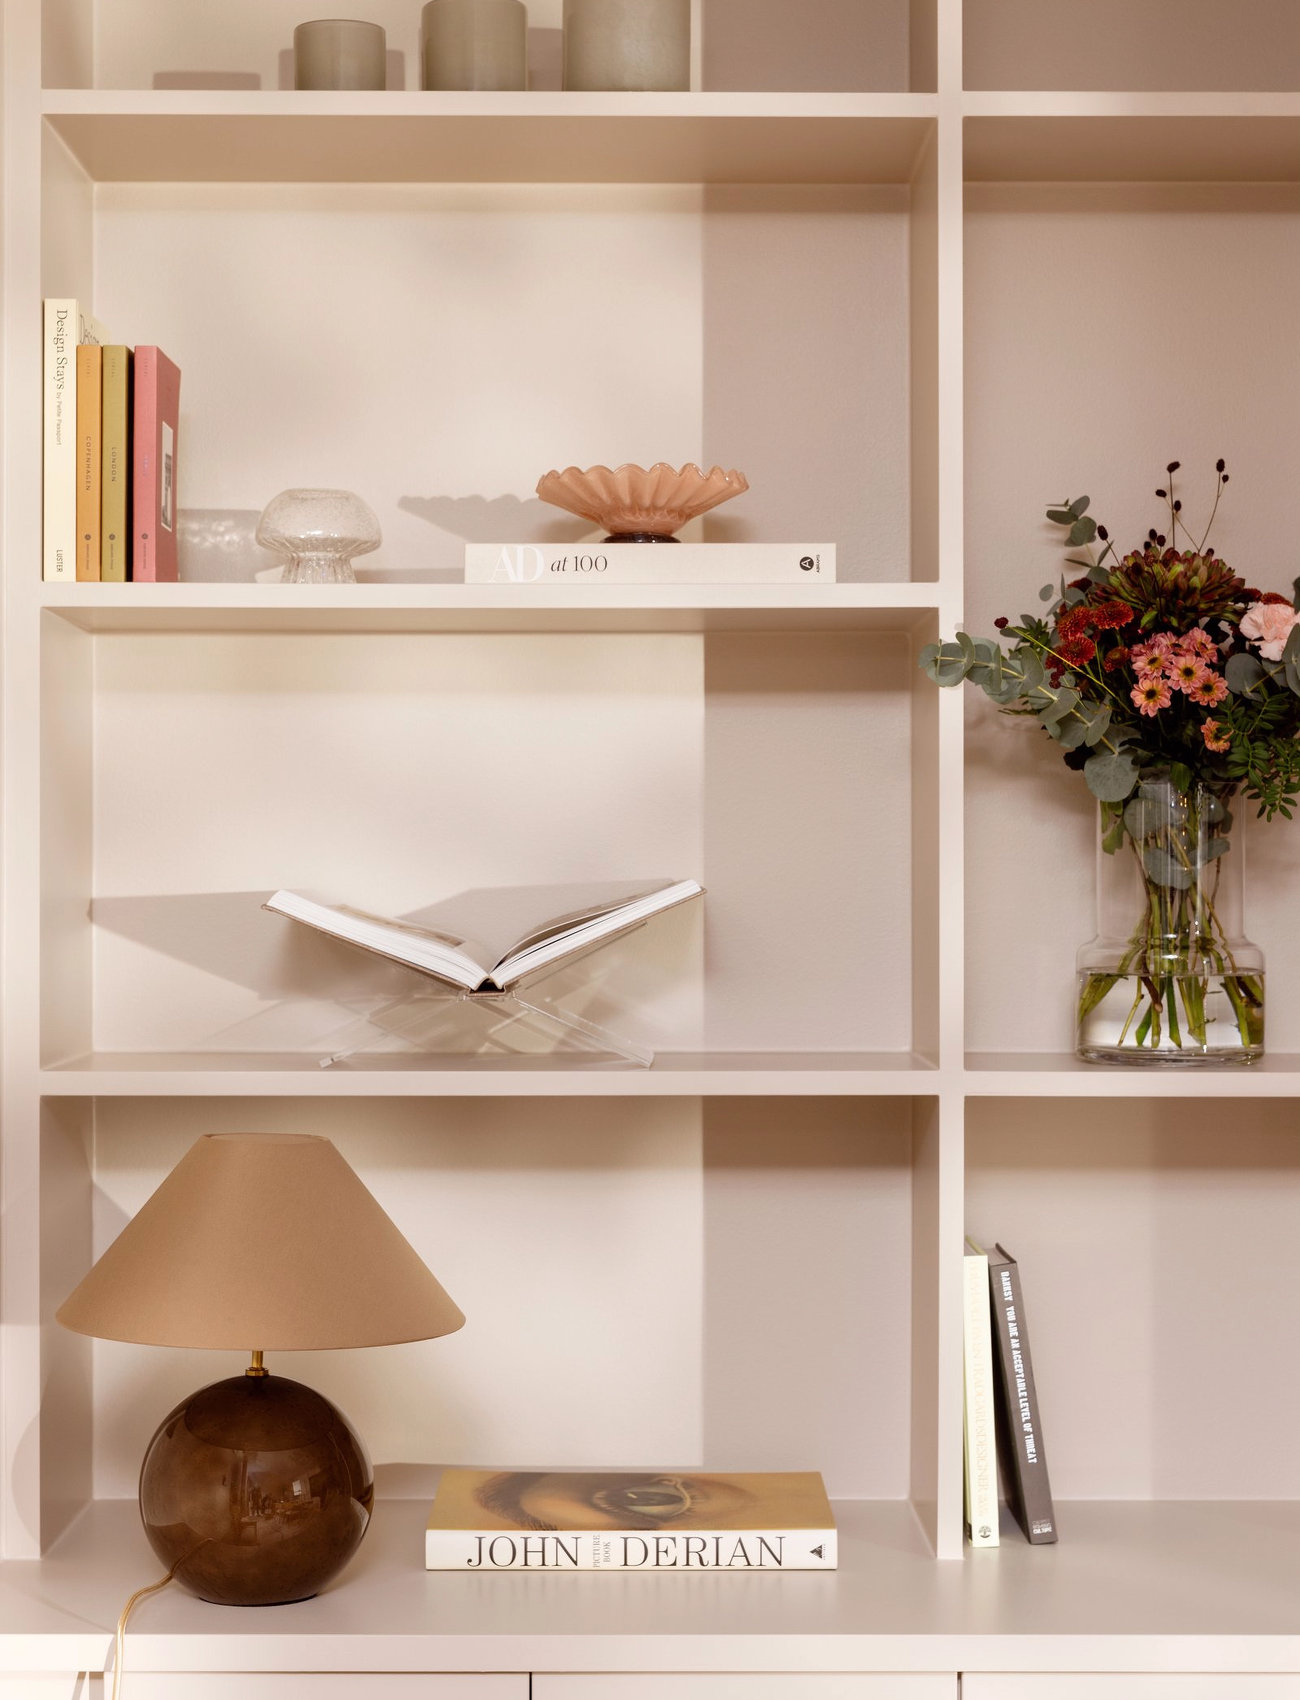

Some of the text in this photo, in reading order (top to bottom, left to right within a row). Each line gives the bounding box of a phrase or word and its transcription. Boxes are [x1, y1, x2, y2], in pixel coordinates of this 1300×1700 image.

[54, 310, 68, 353] Design
[53, 357, 67, 390] Stays
[56, 549, 64, 573] LUSTER
[488, 544, 608, 583] AD at 100
[1000, 1271, 1038, 1464] BANKSY YOU ARE AN ACCEPTABLE LEVEL OF THREAT
[467, 1535, 582, 1568] JOHN
[592, 1534, 601, 1568] PICTURE
[602, 1541, 611, 1563] BOOK
[620, 1535, 787, 1568] DERIAN
